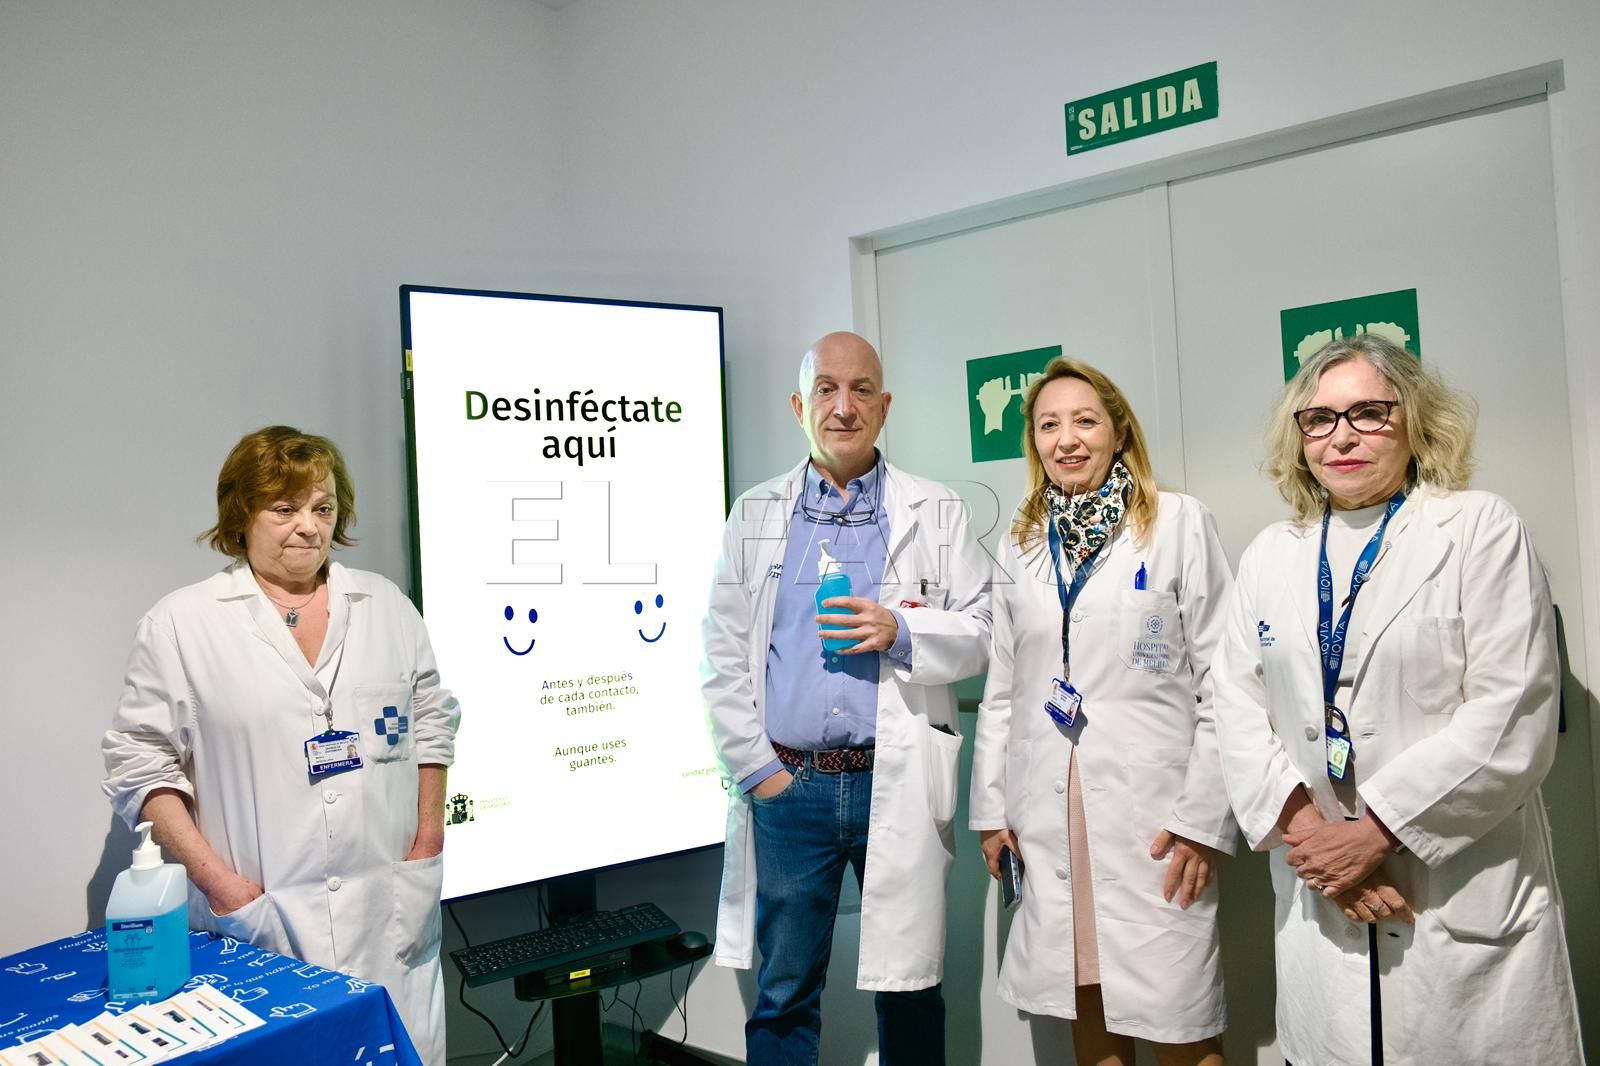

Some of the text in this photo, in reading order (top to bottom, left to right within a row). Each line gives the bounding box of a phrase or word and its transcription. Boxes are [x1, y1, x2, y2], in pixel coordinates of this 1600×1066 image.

[1077, 78, 1203, 141] SALIDA
[465, 388, 682, 423] Desinféctate
[542, 425, 616, 466] aquí
[1320, 560, 1331, 592] IQVIA
[1331, 620, 1346, 658] IQVIA
[542, 670, 633, 690] Antes y después
[540, 686, 639, 705] de cada contacto,
[566, 702, 616, 716] también.
[555, 739, 627, 757] Aunque uses
[320, 759, 354, 771] ENFERMERA
[569, 754, 617, 772] guantes.
